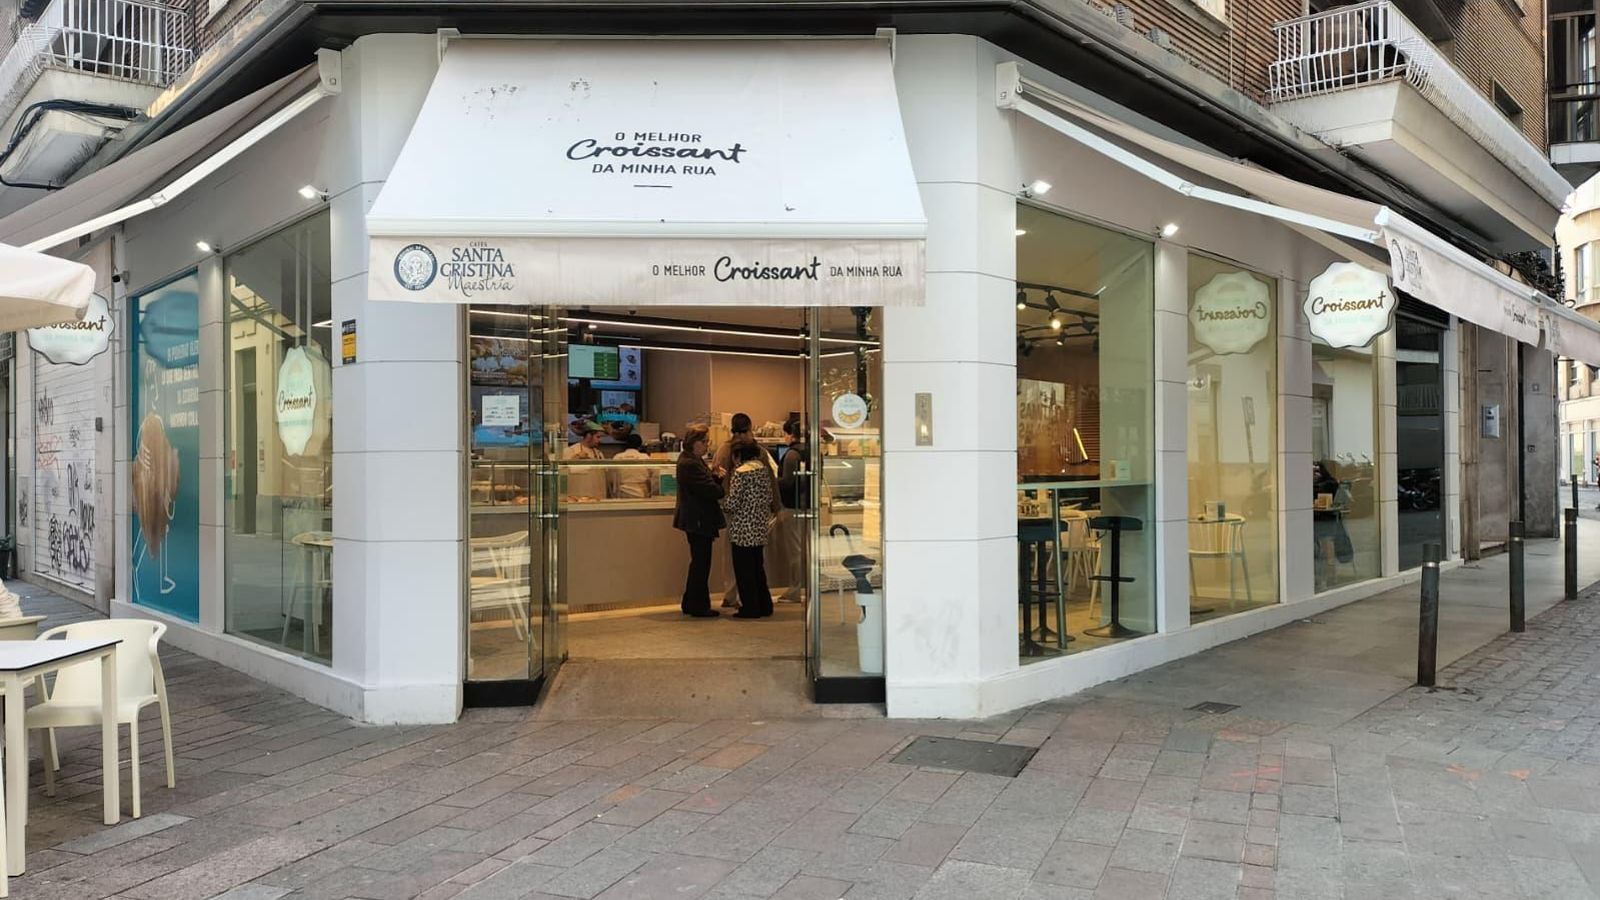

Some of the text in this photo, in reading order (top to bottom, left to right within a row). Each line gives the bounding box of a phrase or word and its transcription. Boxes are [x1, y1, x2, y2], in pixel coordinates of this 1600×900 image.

[615, 132, 702, 143] O MELHOR
[566, 139, 747, 164] Croissant
[592, 163, 717, 176] DA MINHA RUA
[451, 247, 504, 262] SANTA
[440, 262, 515, 277] CRISTINA
[652, 264, 706, 277] O MELHOR
[714, 255, 821, 283] Croissant
[830, 265, 903, 278] DA MINHA RUA
[1311, 290, 1387, 316] Croissant
